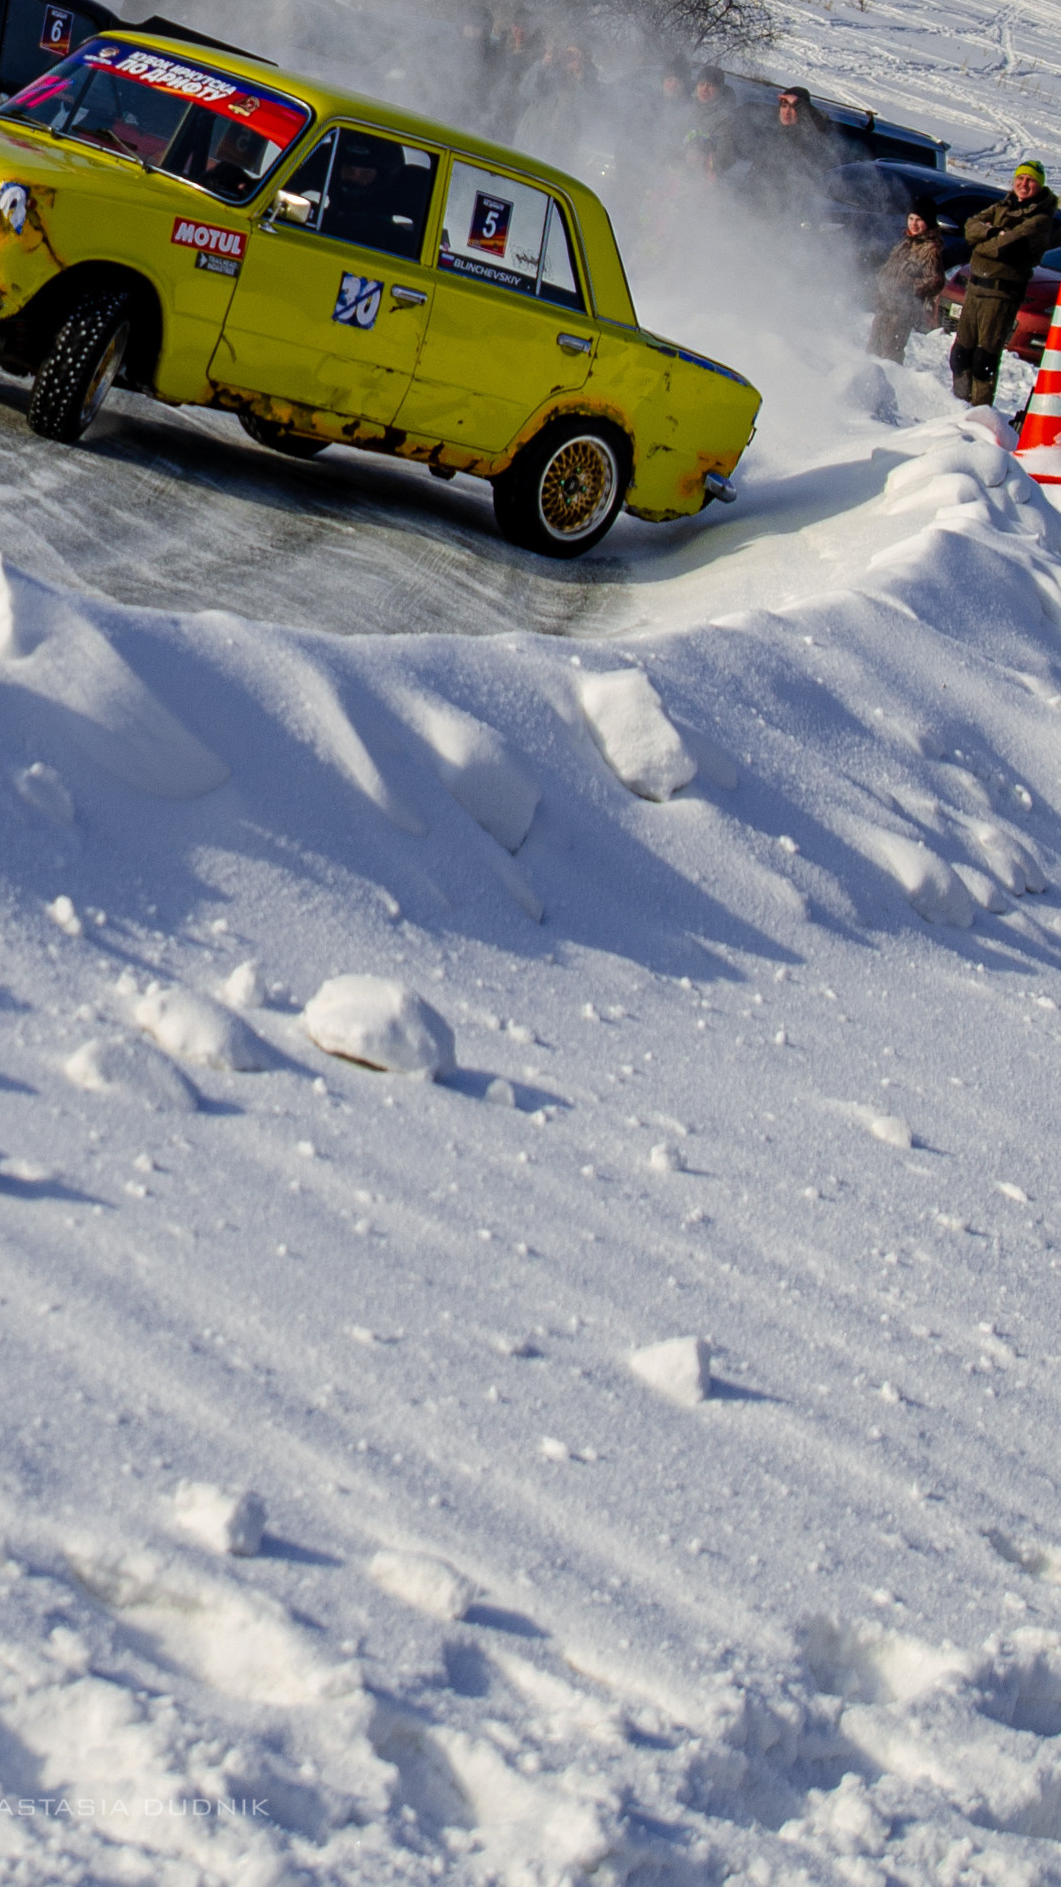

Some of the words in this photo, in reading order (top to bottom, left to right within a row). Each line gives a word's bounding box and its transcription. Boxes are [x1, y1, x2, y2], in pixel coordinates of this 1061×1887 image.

[51, 20, 63, 42] 6
[128, 51, 174, 70] КУБОК
[115, 59, 149, 75] ПО
[140, 69, 230, 101] ДРИФТУ
[482, 211, 499, 238] 5
[175, 222, 241, 255] MOTUL
[453, 258, 521, 286] BLINCHEVSKIY
